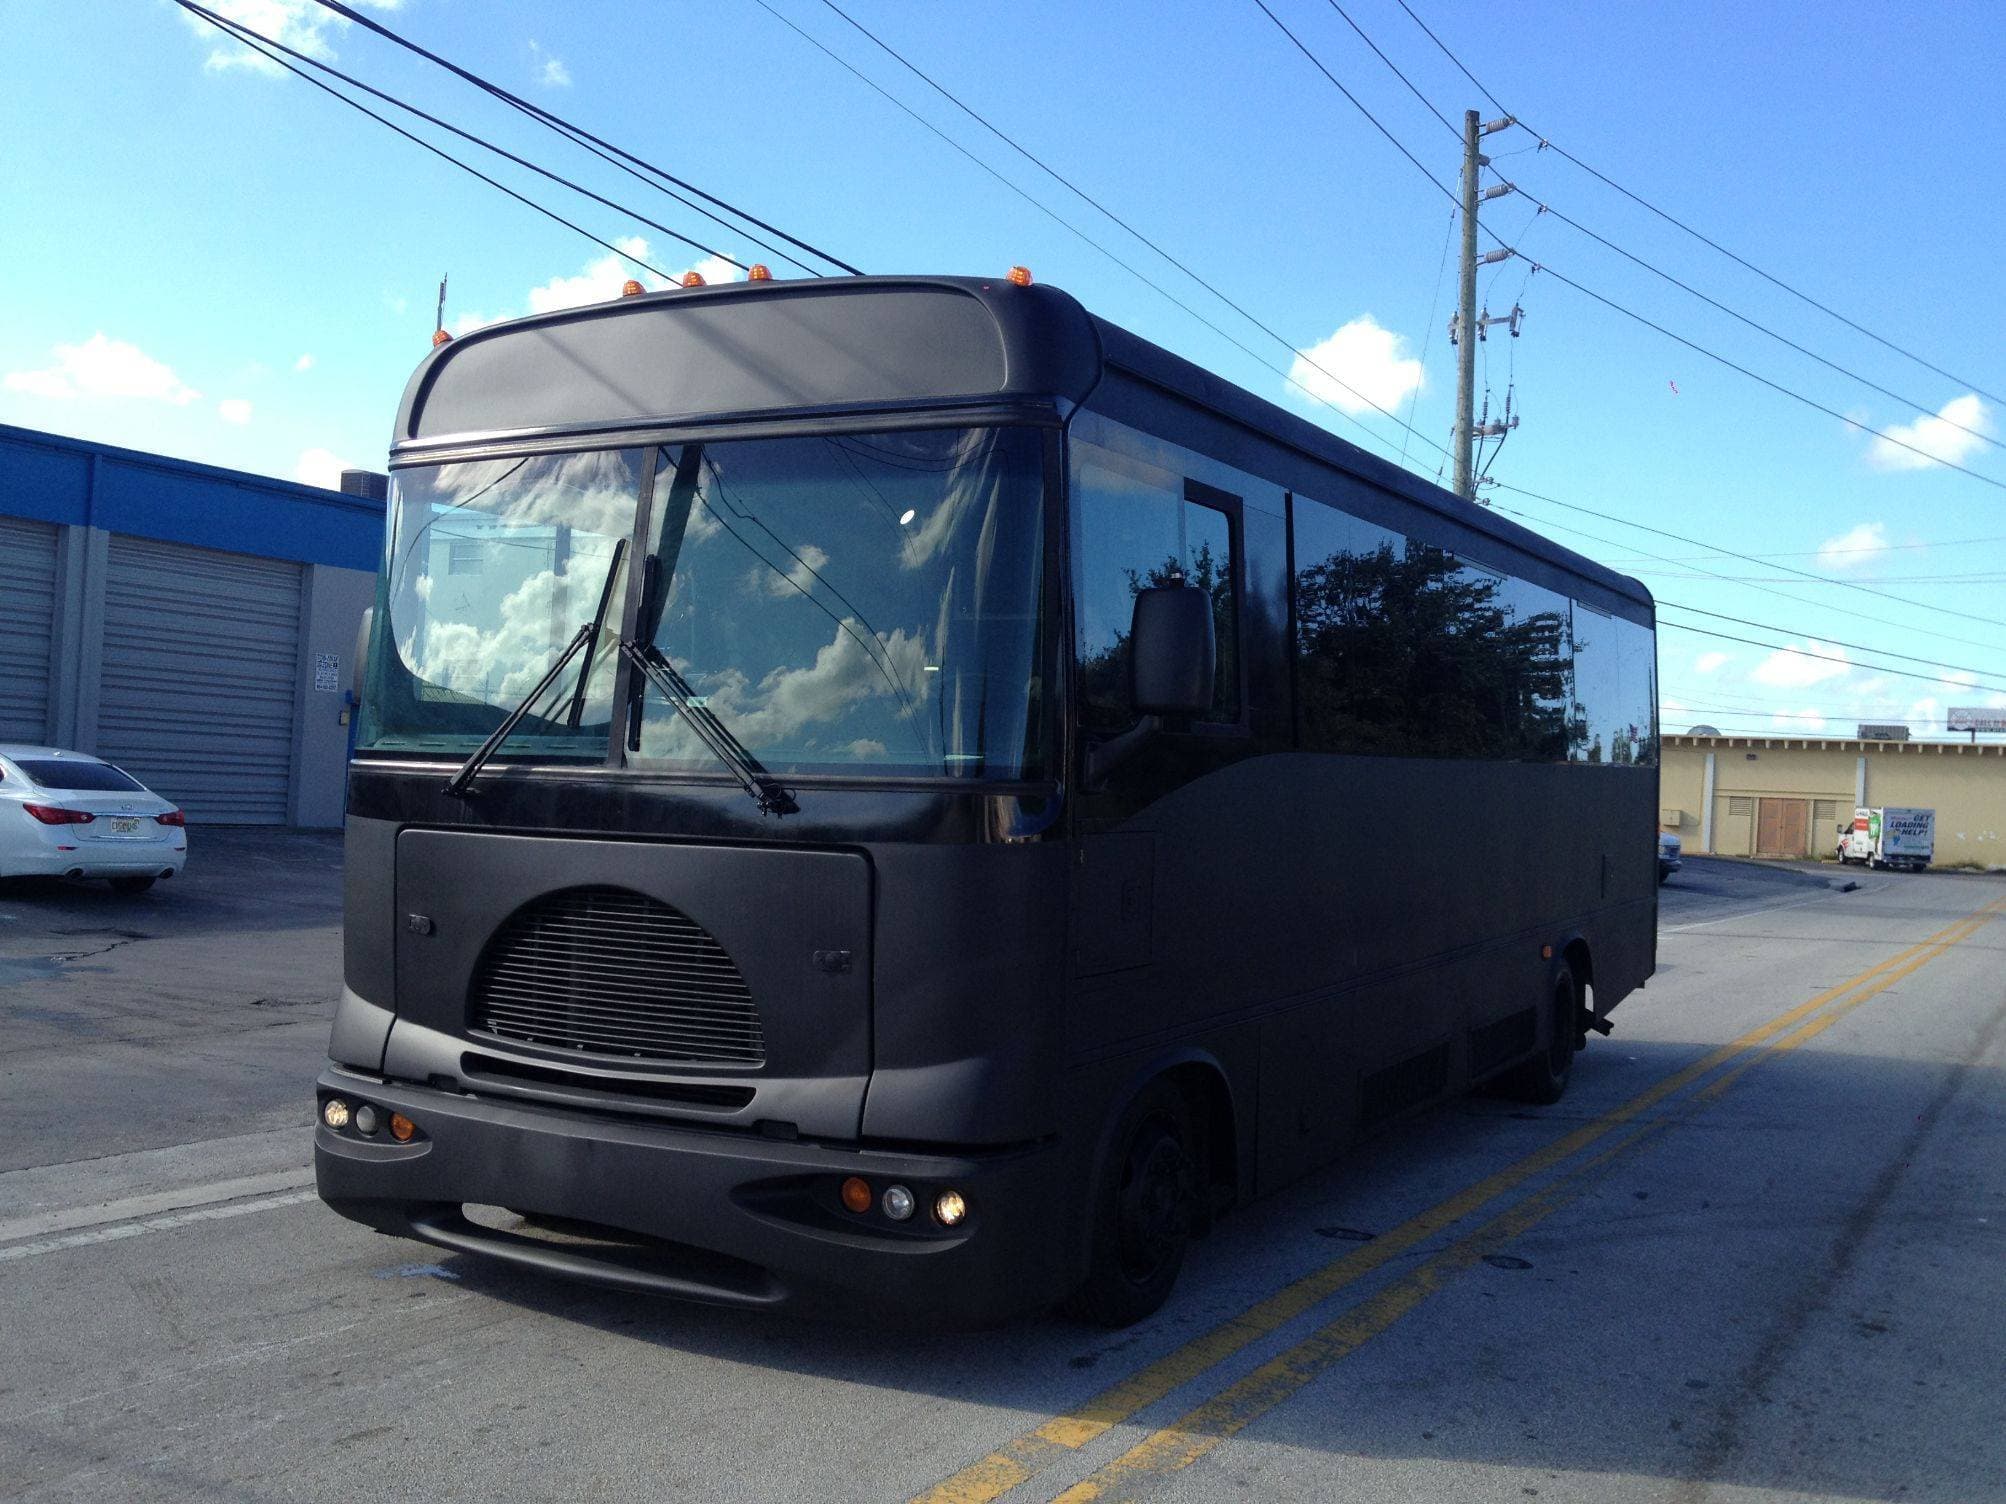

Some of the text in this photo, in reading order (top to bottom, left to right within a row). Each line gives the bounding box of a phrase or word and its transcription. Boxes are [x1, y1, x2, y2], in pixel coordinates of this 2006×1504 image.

[1913, 814, 1930, 822] GET
[1890, 821, 1929, 829] LOADING
[1900, 828, 1929, 836] HELP!
